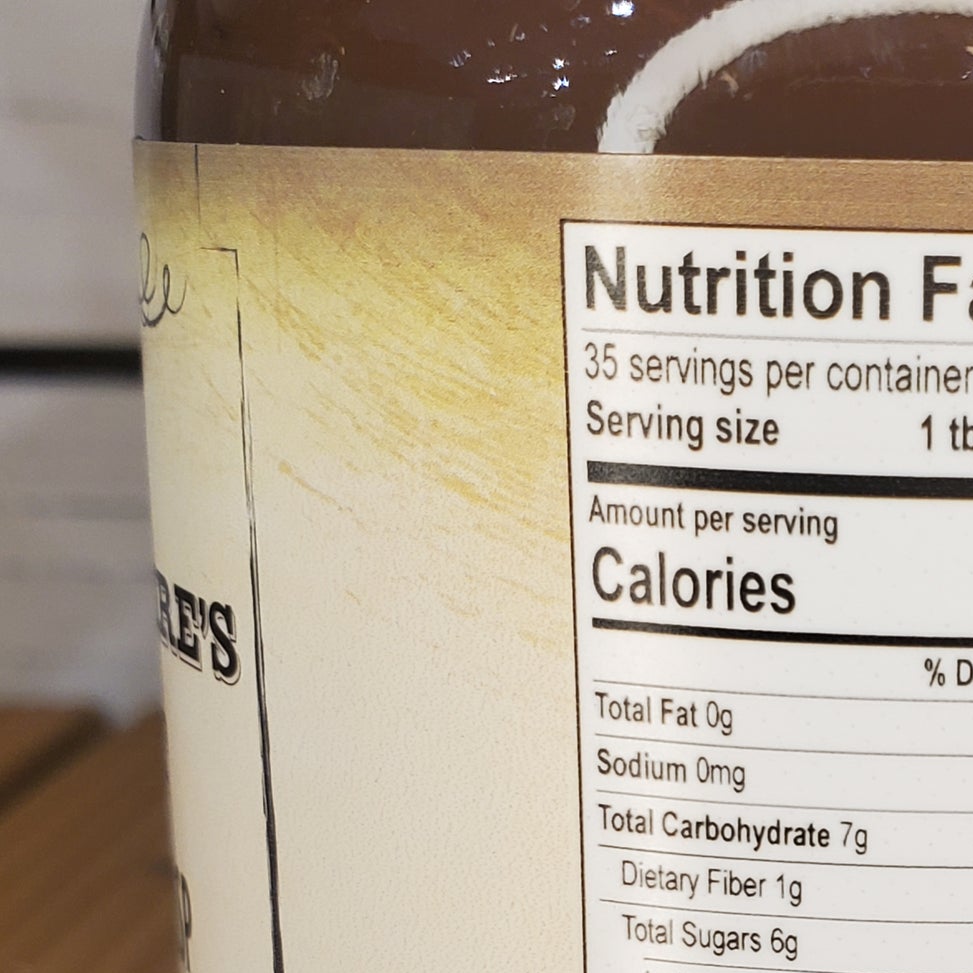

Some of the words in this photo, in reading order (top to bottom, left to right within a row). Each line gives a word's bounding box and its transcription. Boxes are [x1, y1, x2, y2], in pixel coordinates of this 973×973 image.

[585, 245, 890, 320] Nutrition
[585, 342, 617, 380] 35
[630, 348, 753, 396] servings
[767, 360, 815, 397] per
[827, 356, 973, 393] container
[587, 400, 703, 451] Serving
[716, 409, 779, 445] size
[921, 415, 932, 450] 1
[589, 495, 684, 529] Amount
[695, 510, 734, 537] per
[743, 507, 838, 545] serving
[592, 546, 795, 615] Calories
[924, 658, 945, 686] %
[595, 691, 651, 723] Total
[661, 698, 698, 727] Fat
[707, 701, 732, 736] 0g
[597, 748, 686, 783] Sodium
[697, 757, 745, 793] 0mg
[598, 804, 653, 835] Total
[662, 811, 830, 852] Carbohydrate
[840, 821, 867, 855] 7g
[622, 860, 699, 899] Dietary
[708, 869, 766, 897] Fiber
[777, 874, 802, 907] 1g
[622, 914, 672, 944] Total
[682, 921, 761, 956] Sugars
[771, 928, 797, 961] 6g
